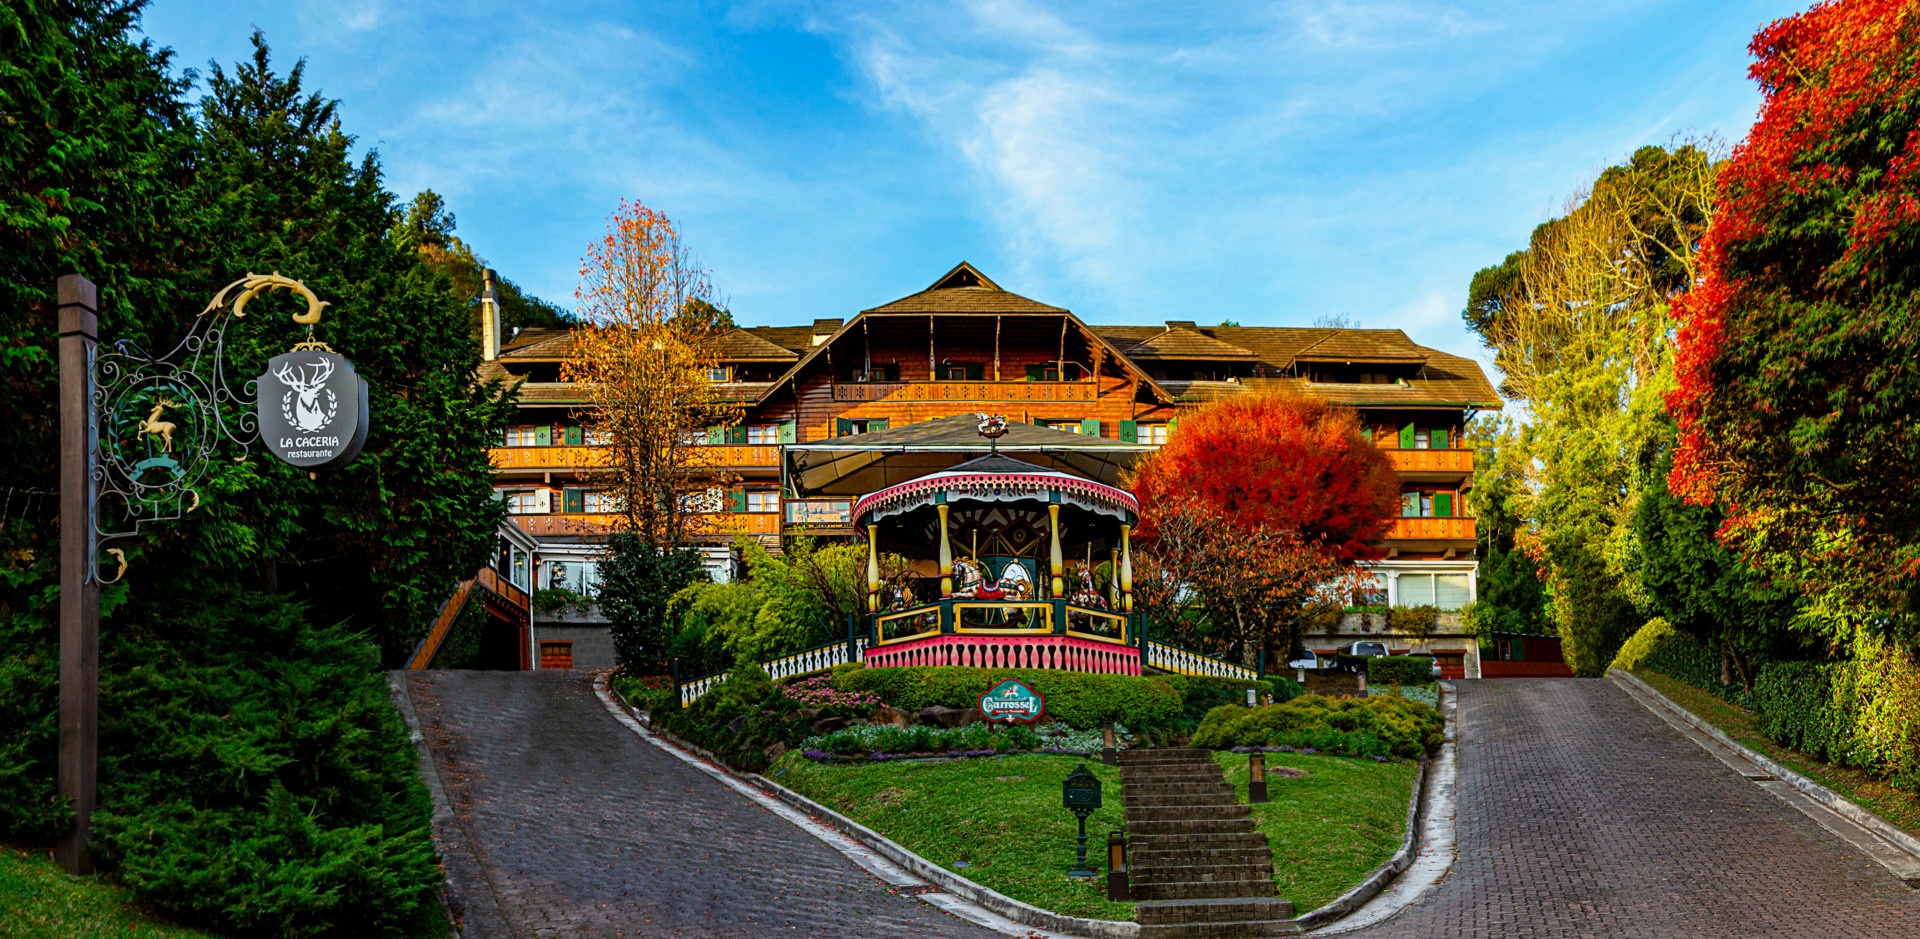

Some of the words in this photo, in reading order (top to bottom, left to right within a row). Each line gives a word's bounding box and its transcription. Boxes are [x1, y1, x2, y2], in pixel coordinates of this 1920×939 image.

[280, 437, 293, 448] LA
[295, 436, 339, 447] CACERIA
[287, 449, 332, 458] restaurante
